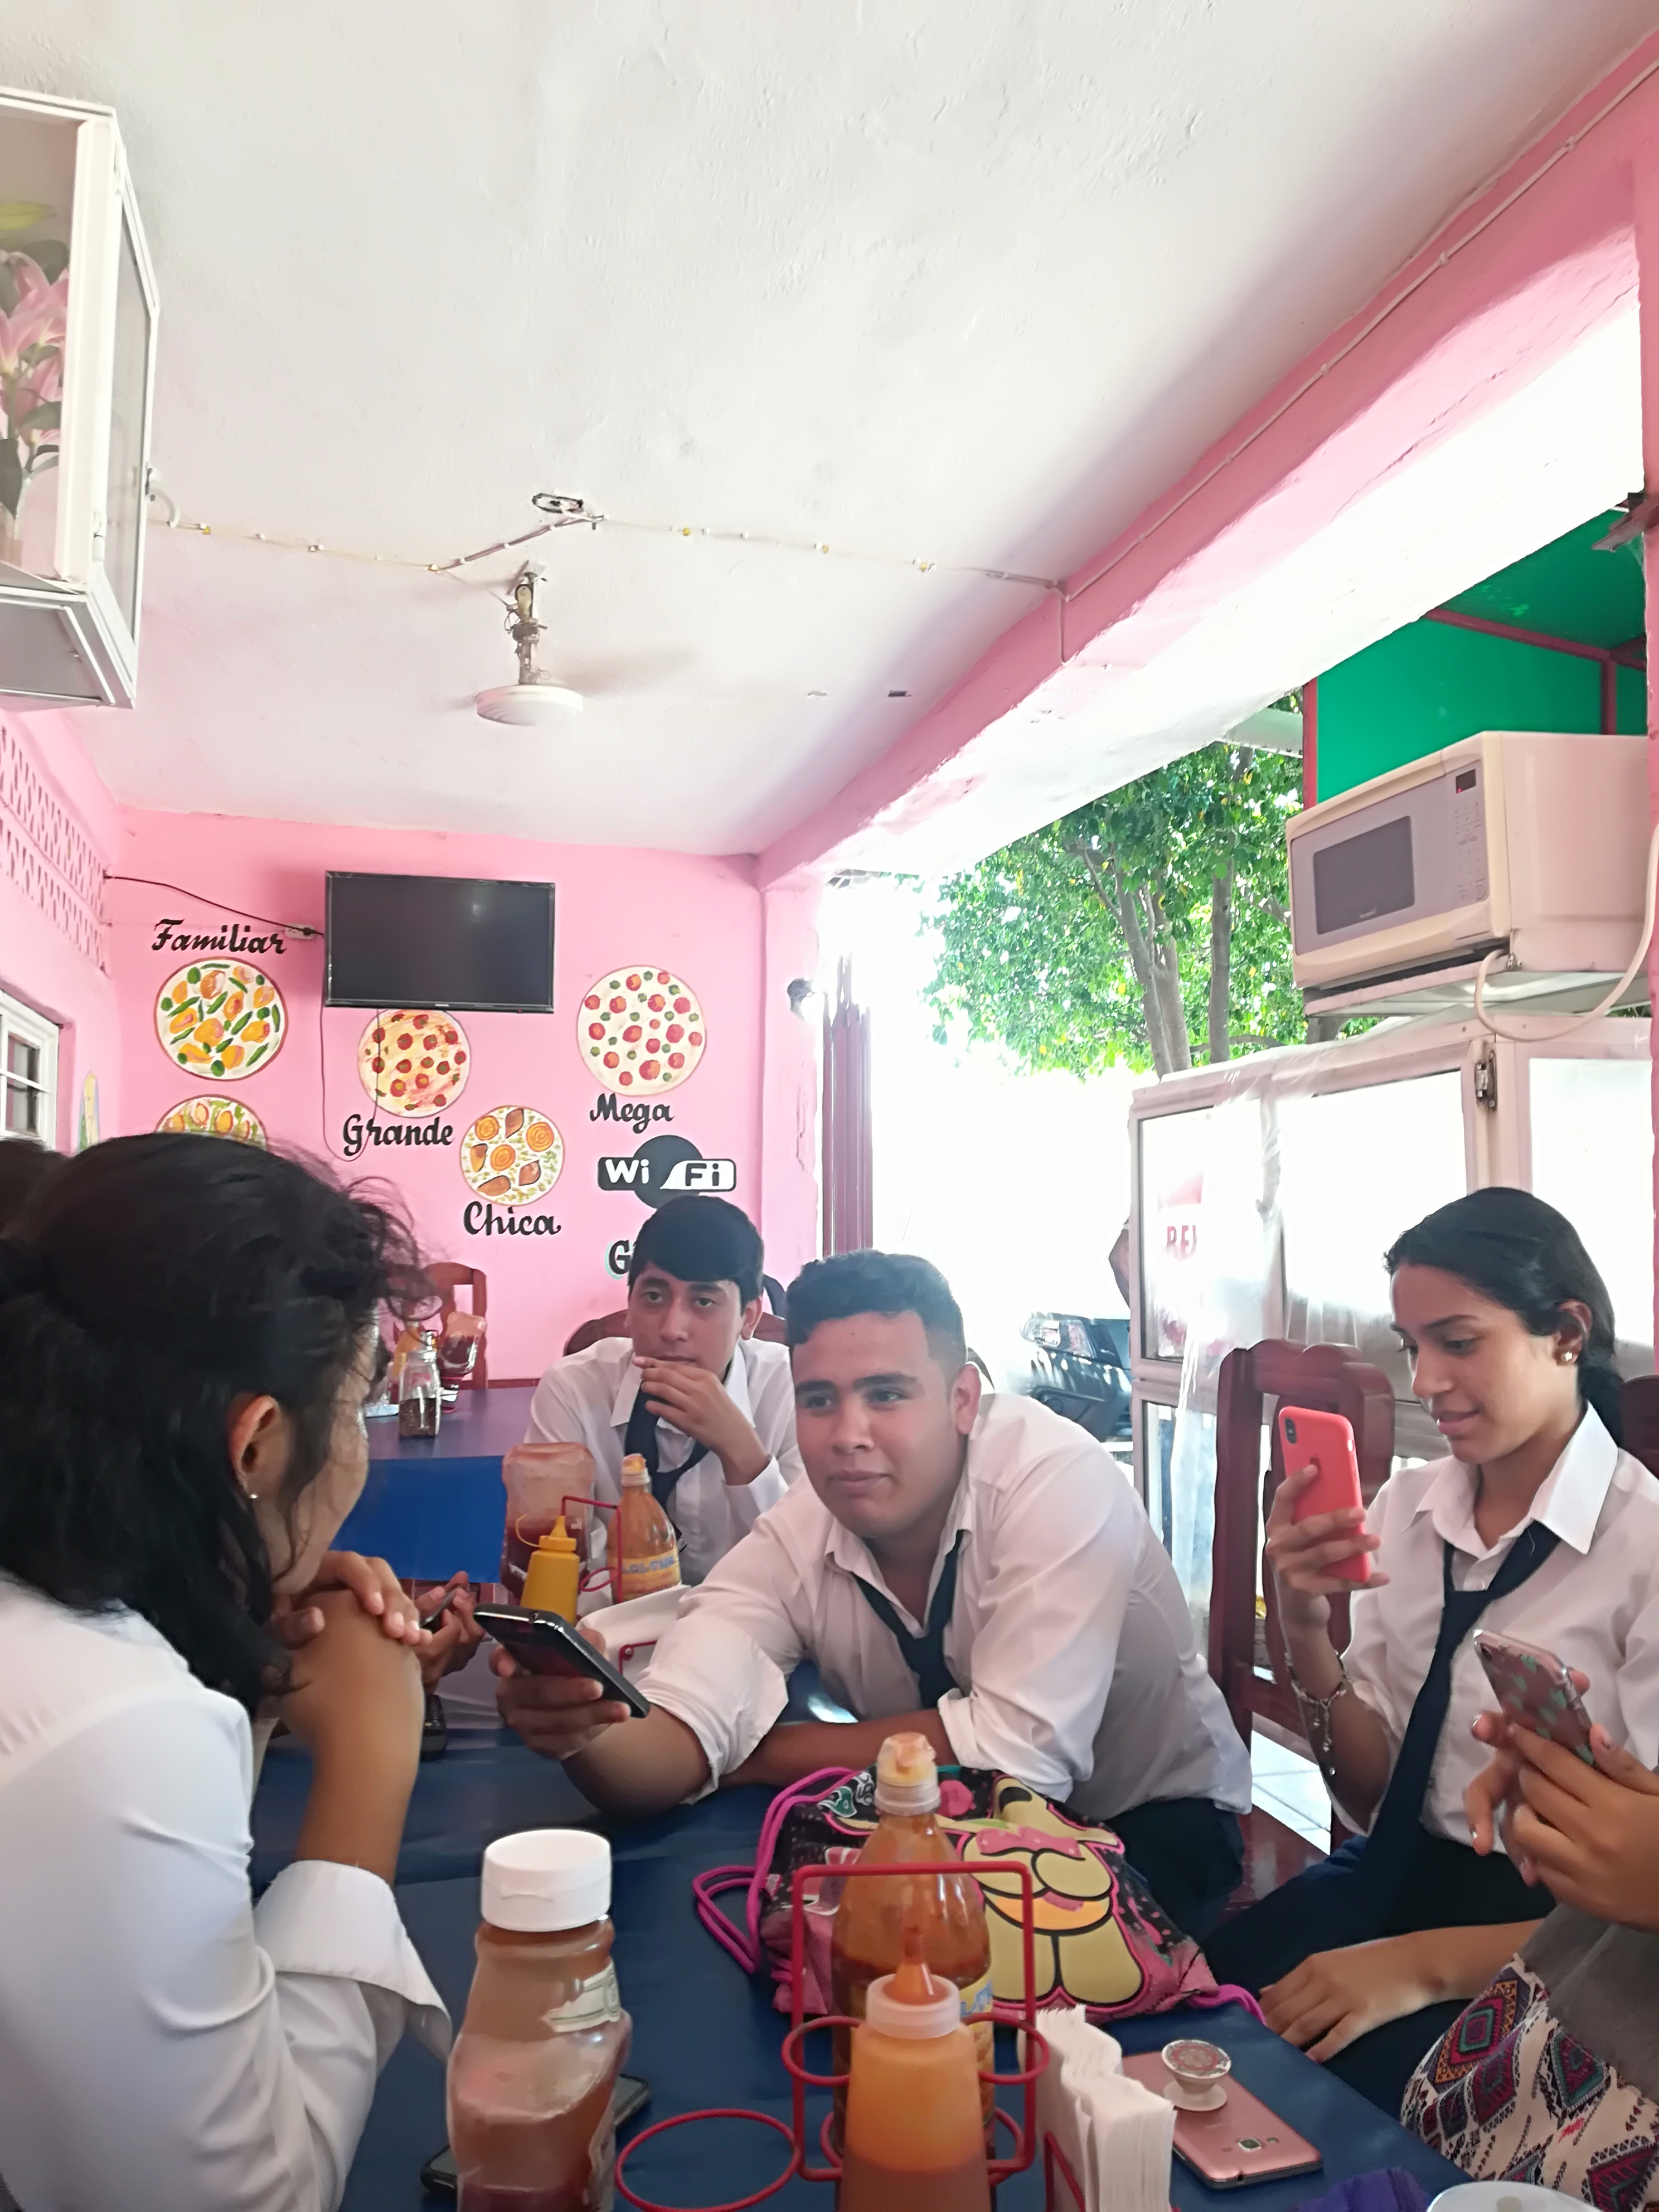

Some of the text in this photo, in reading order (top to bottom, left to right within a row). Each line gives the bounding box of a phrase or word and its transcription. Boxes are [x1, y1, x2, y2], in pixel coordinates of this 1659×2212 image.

[152, 919, 287, 954] Familiar
[589, 1093, 675, 1134] Mega
[343, 1114, 455, 1156] Grande
[605, 1159, 720, 1186] Wi Fi
[463, 1201, 561, 1236] Chica
